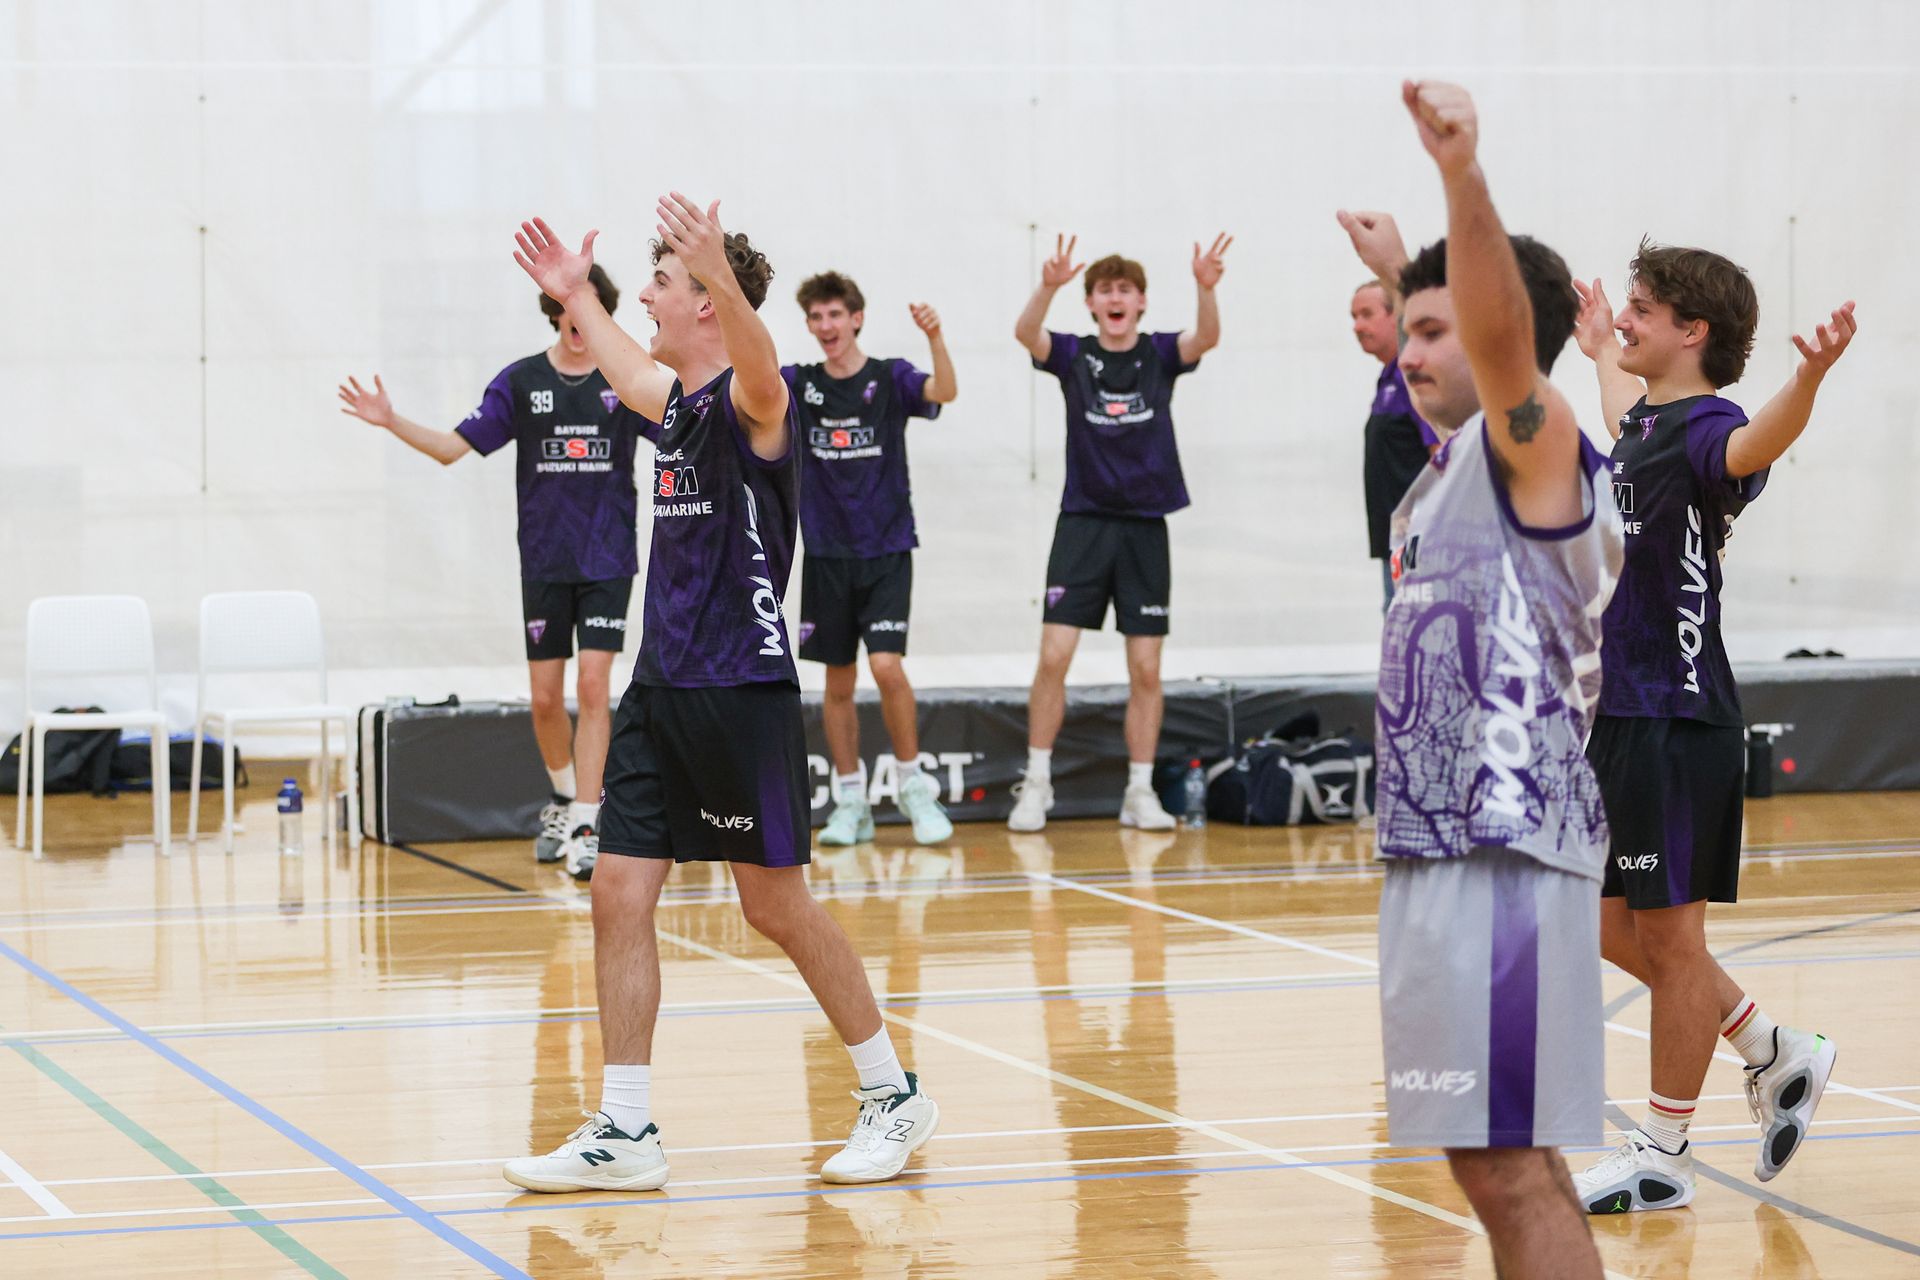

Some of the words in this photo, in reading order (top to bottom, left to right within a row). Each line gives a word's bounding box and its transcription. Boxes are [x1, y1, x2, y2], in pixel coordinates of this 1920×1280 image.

[530, 390, 554, 414] 39
[554, 425, 599, 435] BAYSIDE
[809, 427, 874, 449] BSM
[541, 438, 611, 459] BSM
[700, 808, 754, 832] WOLVES
[1391, 1069, 1477, 1096] WOLVES
